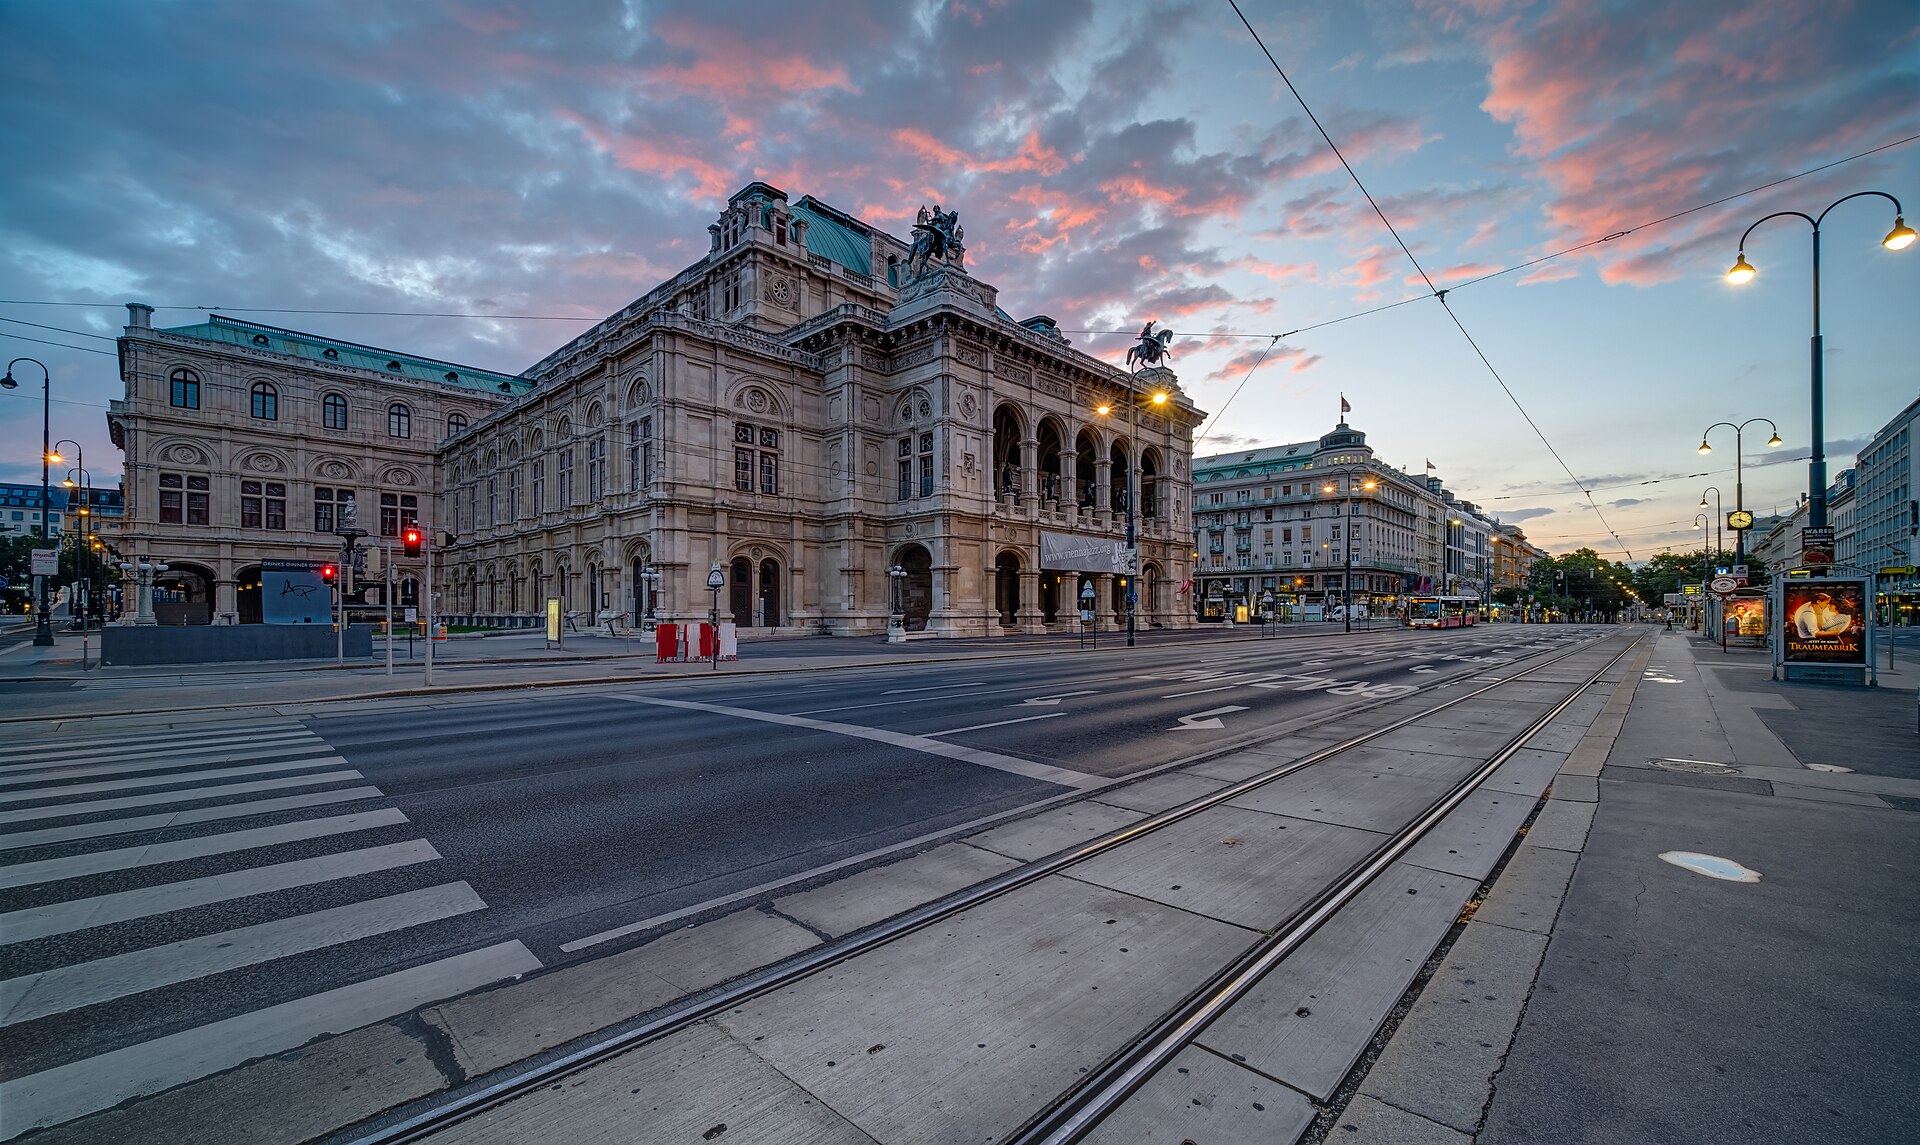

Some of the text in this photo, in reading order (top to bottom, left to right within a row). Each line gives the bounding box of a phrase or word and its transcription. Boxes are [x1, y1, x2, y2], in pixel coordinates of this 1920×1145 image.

[1045, 544, 1111, 562] www.viennajazz.org
[1788, 642, 1859, 652] TRAUMFABRIK
[1249, 673, 1420, 698] GRAZ
